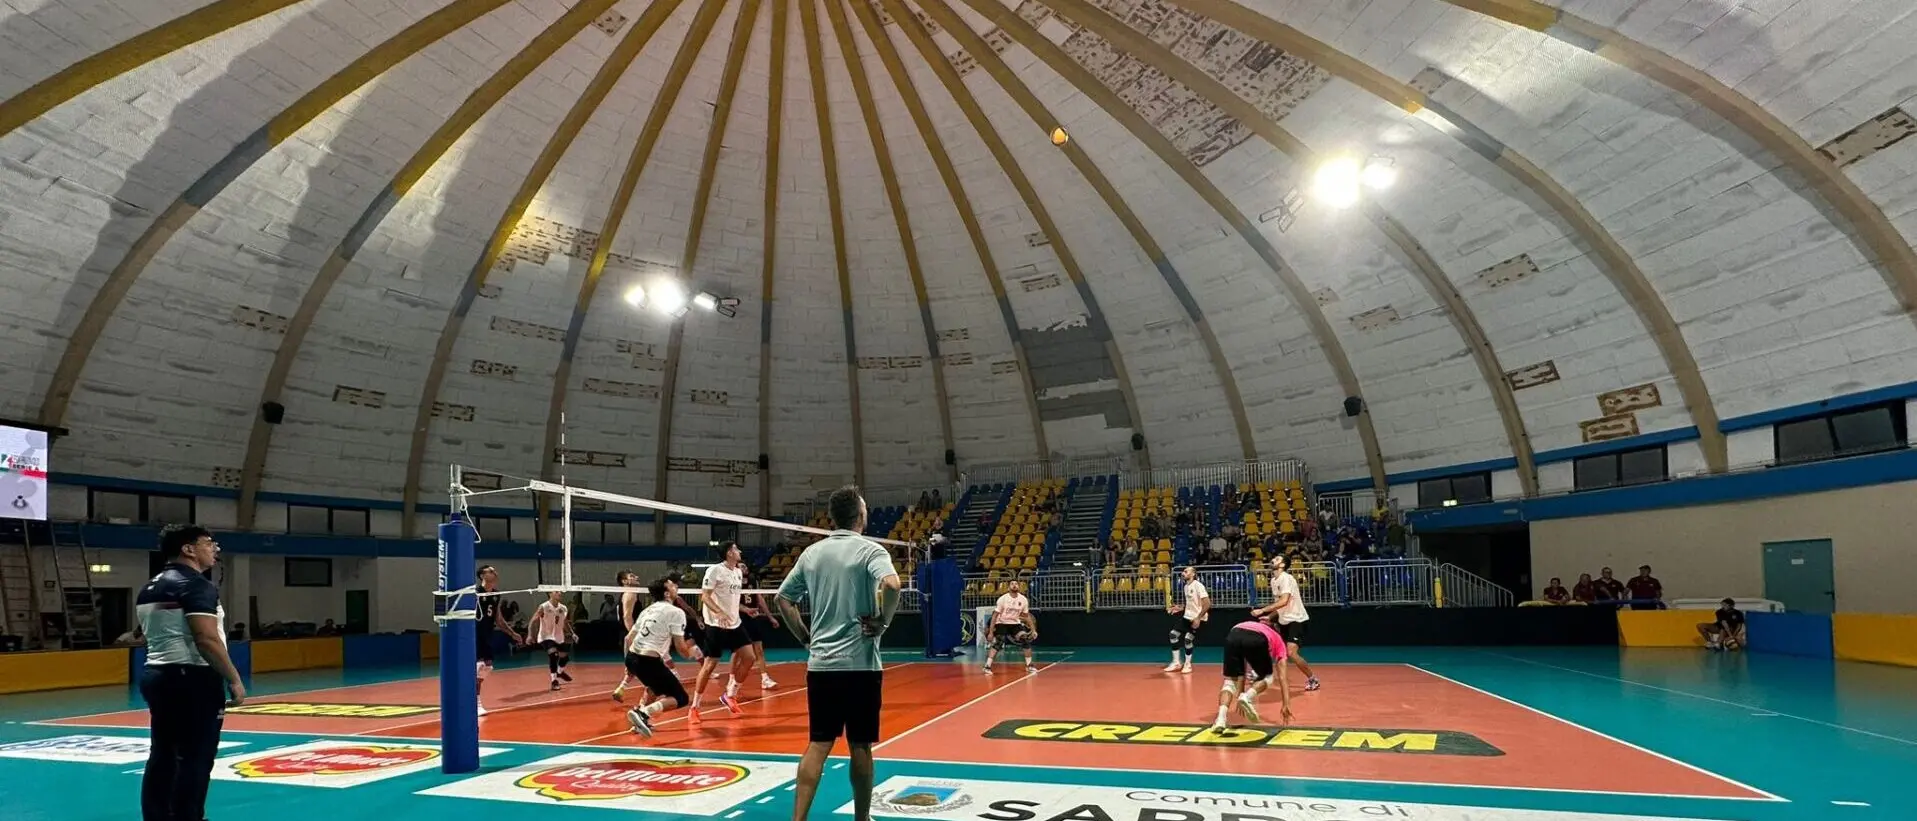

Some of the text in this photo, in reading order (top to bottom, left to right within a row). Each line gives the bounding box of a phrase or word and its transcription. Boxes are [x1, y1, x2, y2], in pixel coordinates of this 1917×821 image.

[438, 538, 446, 588] SYSTEM
[487, 604, 493, 617] 5
[1013, 722, 1438, 751] CREDEM
[551, 767, 727, 786] Del Monte
[1125, 790, 1410, 819] Comune di
